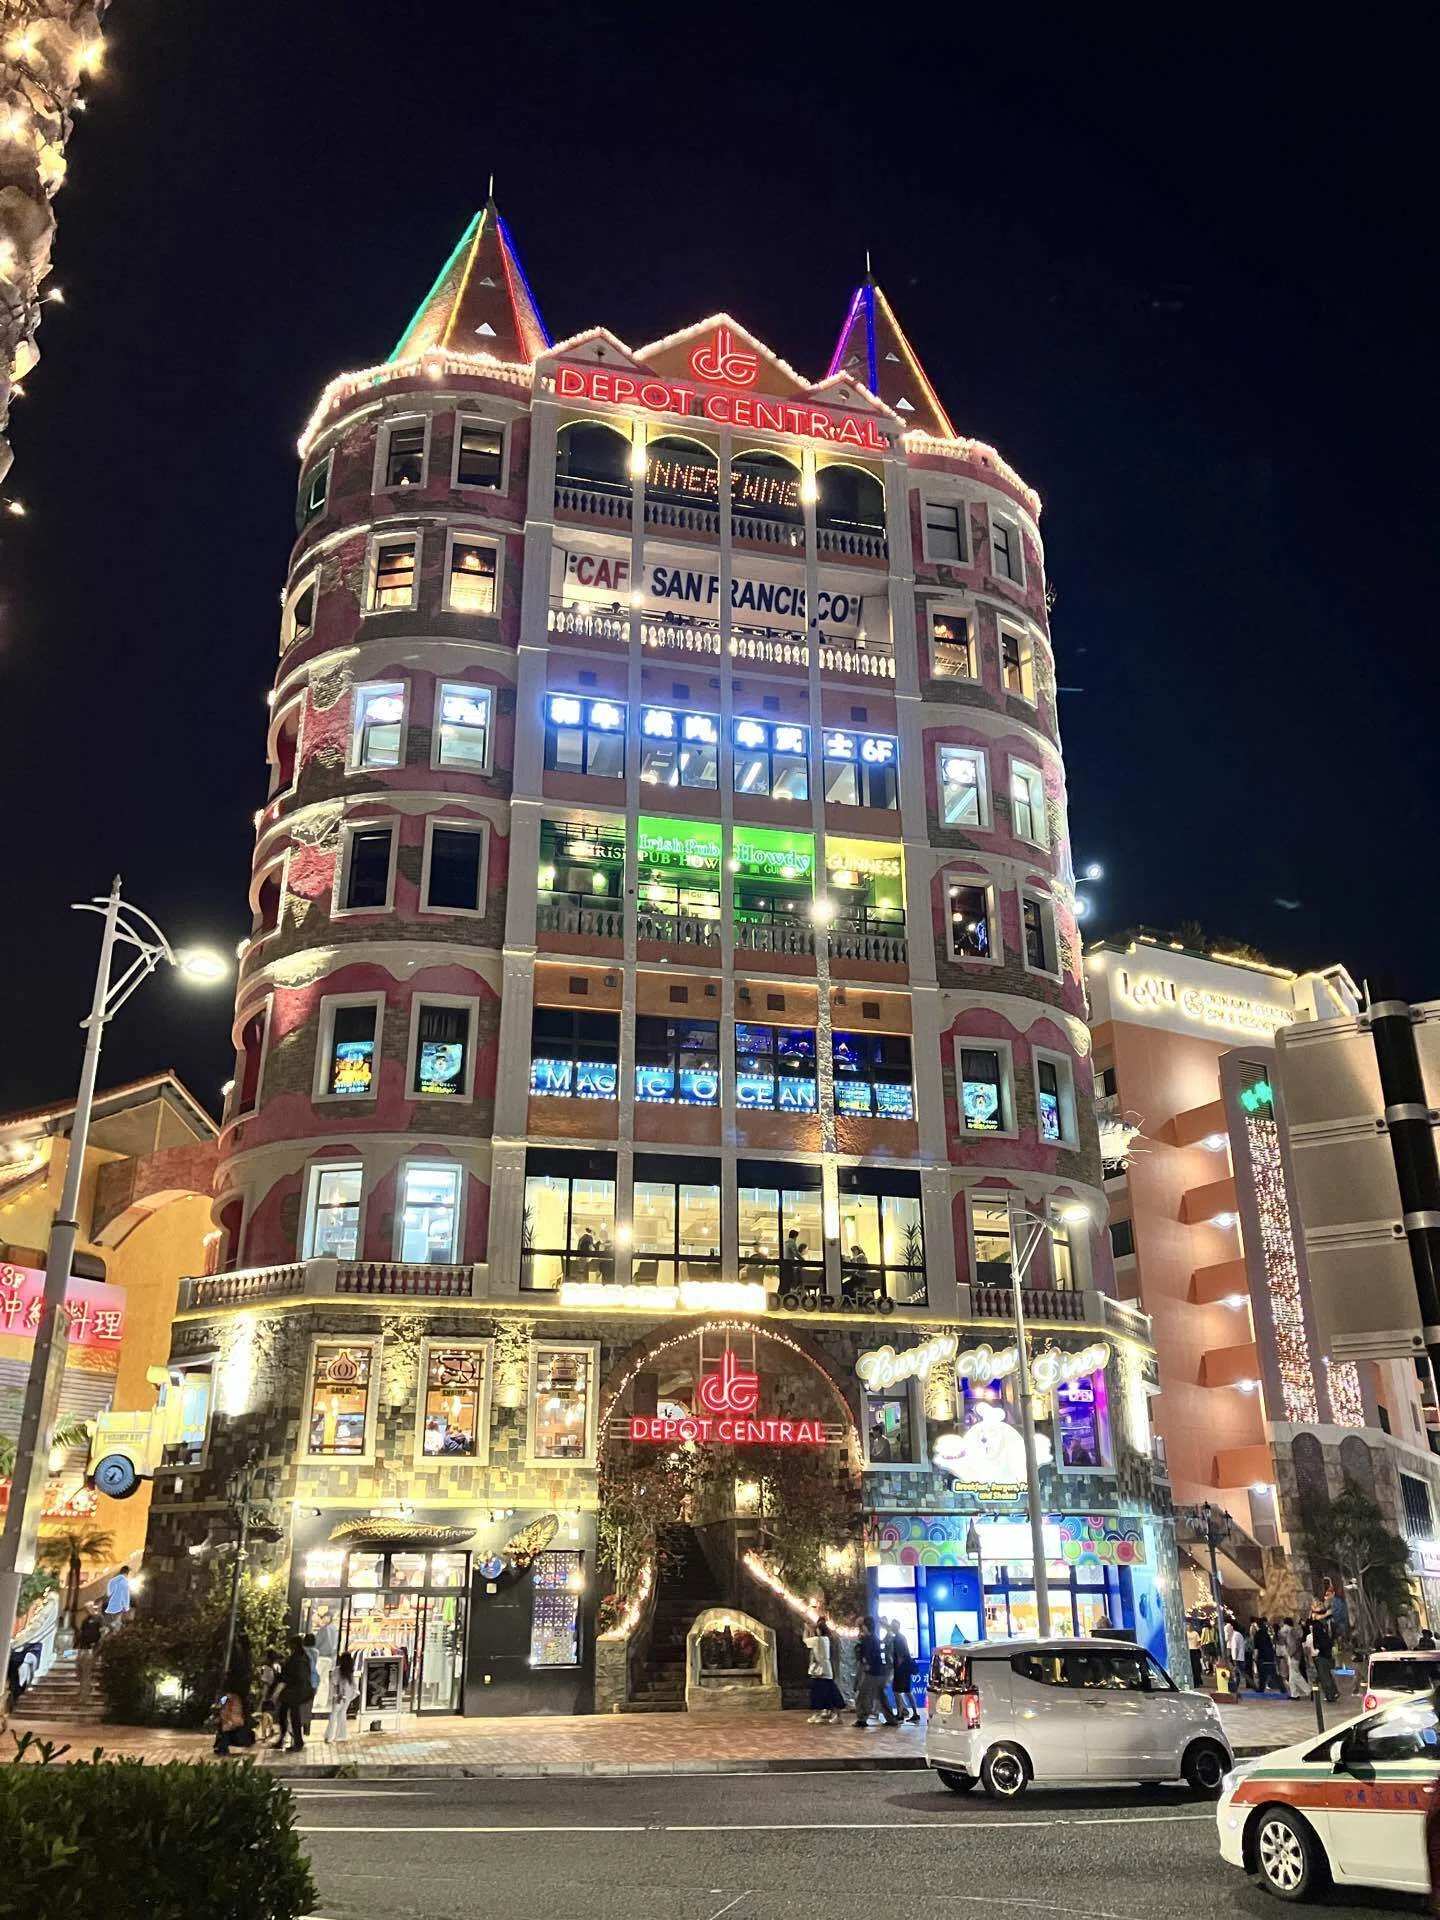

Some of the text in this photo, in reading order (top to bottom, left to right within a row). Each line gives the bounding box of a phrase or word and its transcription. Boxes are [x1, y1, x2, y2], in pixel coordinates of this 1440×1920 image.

[560, 367, 887, 448] DEPOT CENTRAL
[630, 459, 718, 494] INNER
[742, 474, 800, 507] WINE
[577, 555, 645, 591] CAF
[651, 566, 703, 602] SAN
[637, 850, 671, 864] PUB
[639, 834, 720, 857] Irish Pub
[735, 844, 810, 872] Howdy
[827, 854, 901, 876] GUINNESS
[546, 1068, 667, 1096] MAGIC
[692, 1078, 816, 1108] OCEAN
[856, 1335, 1110, 1391] Burger Bea Diner
[631, 1419, 827, 1443] DEPOT CENTRAL
